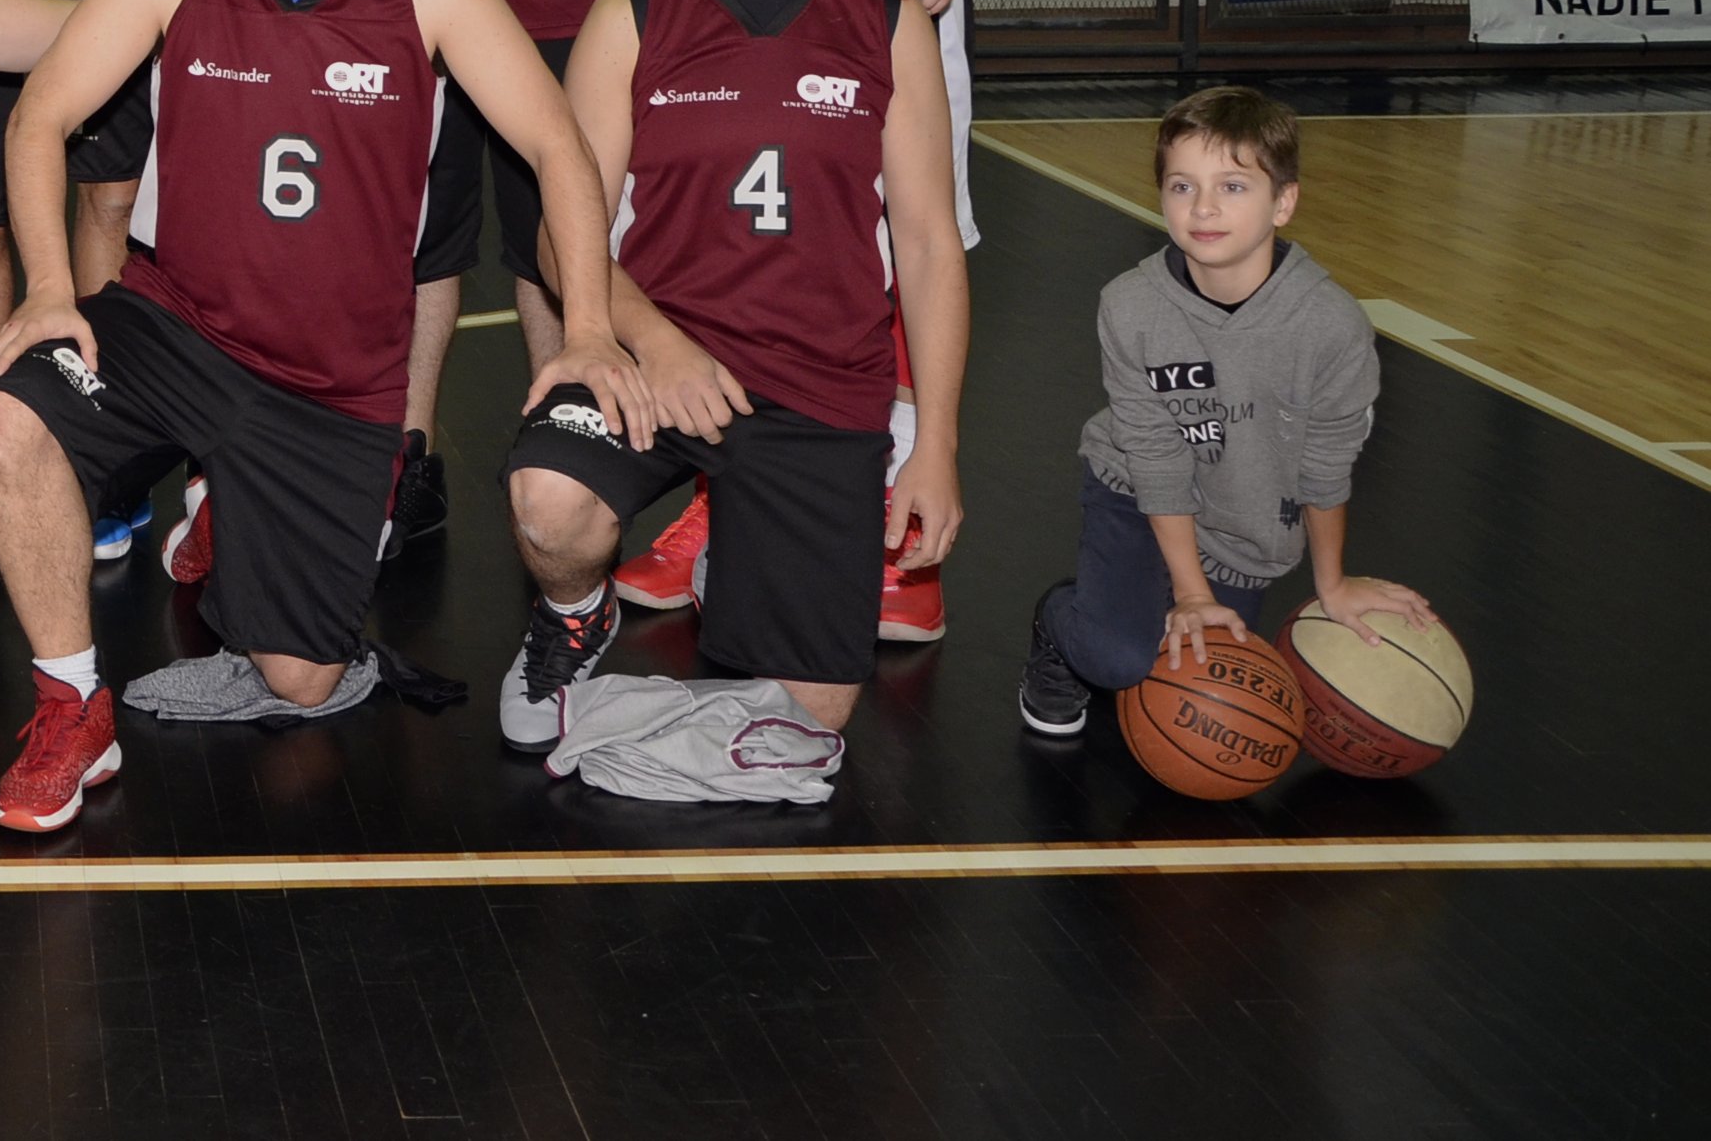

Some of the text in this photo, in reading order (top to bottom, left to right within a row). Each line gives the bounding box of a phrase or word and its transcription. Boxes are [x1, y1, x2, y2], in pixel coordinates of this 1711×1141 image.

[205, 62, 271, 84] Santander
[324, 61, 390, 94] ORT
[667, 86, 740, 104] Santander
[796, 74, 861, 108] ORT
[260, 134, 320, 221] 6
[730, 146, 789, 233] 4
[1174, 700, 1288, 769] SPALDING
